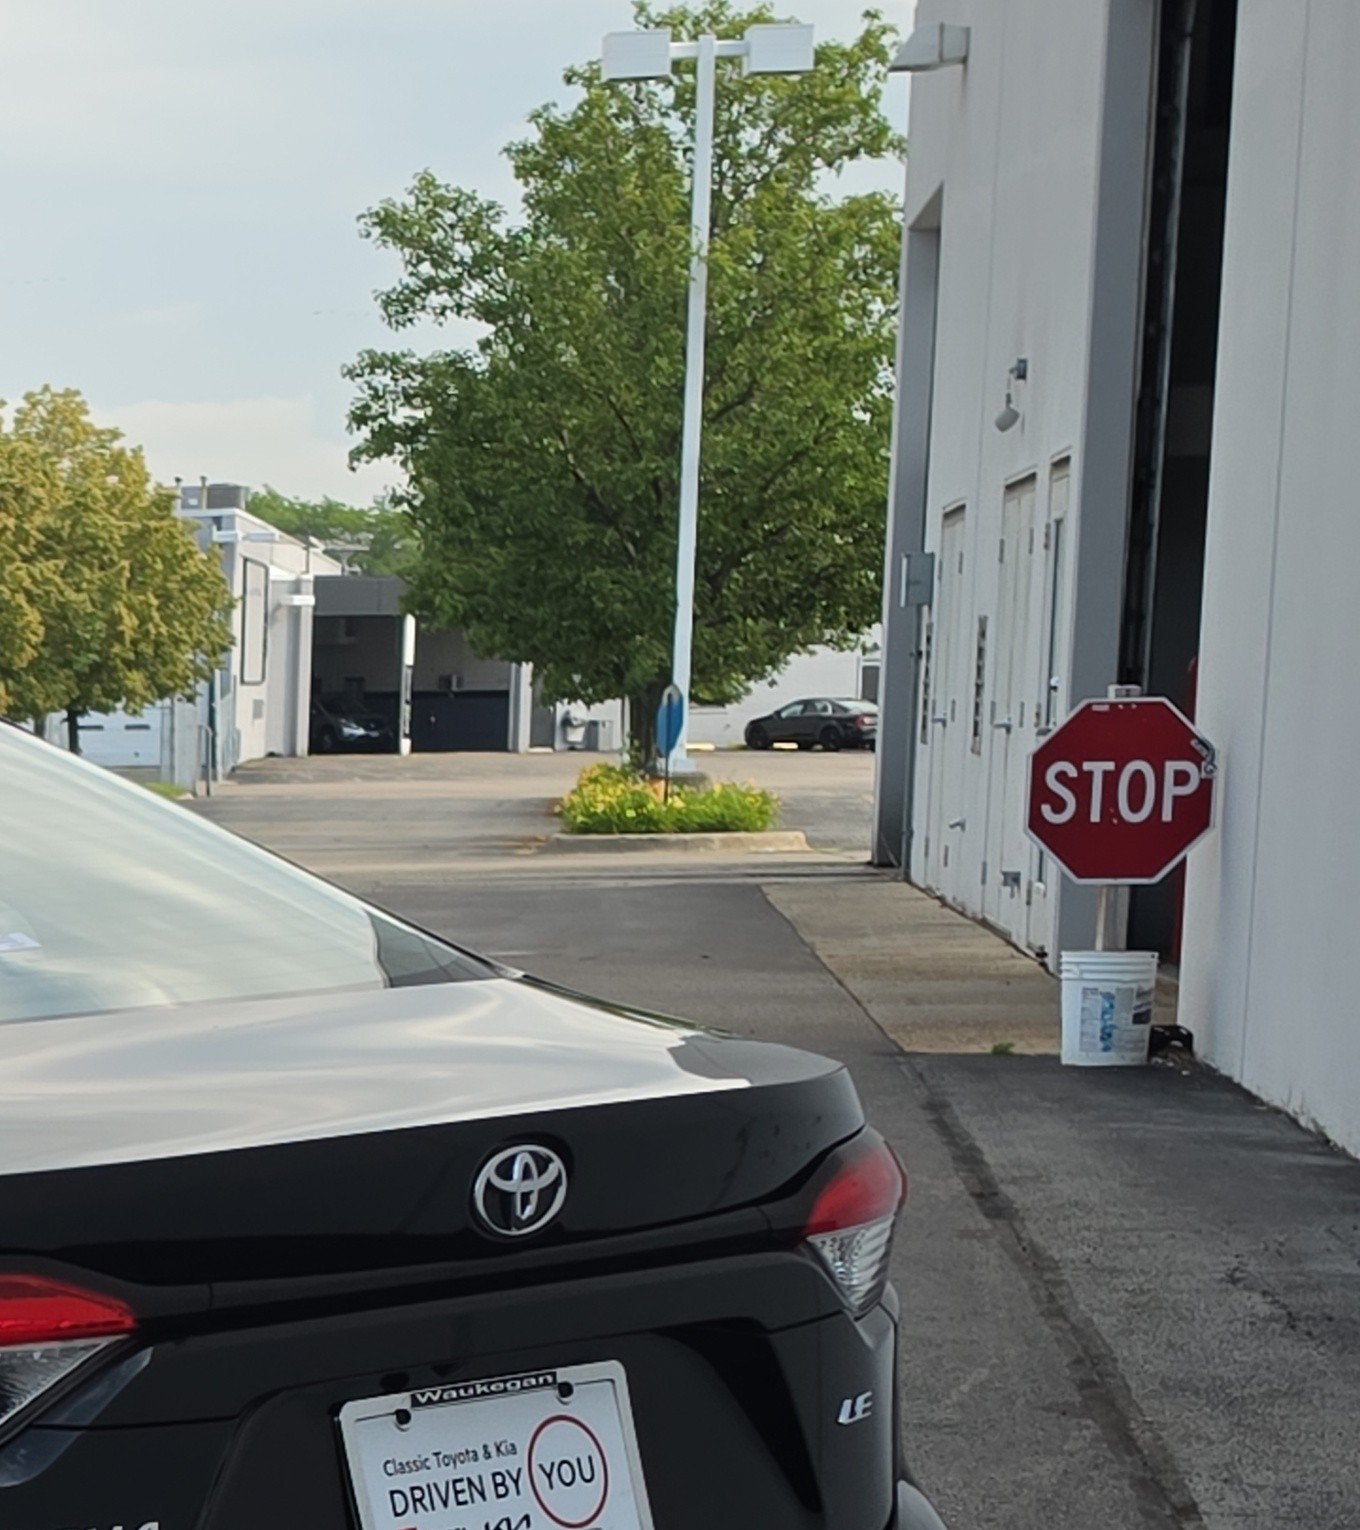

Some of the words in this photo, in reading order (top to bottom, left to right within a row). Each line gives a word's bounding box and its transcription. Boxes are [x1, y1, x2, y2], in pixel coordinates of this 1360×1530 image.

[1040, 760, 1201, 825] STOP
[415, 1374, 554, 1403] Waukegan
[837, 1391, 873, 1425] LE
[383, 1454, 431, 1477] Classic
[432, 1448, 479, 1470] Toyota
[482, 1444, 492, 1460] &
[494, 1440, 518, 1457] Kia
[389, 1474, 487, 1518] DRIVEN
[491, 1467, 522, 1500] BY
[538, 1454, 596, 1491] YOU
